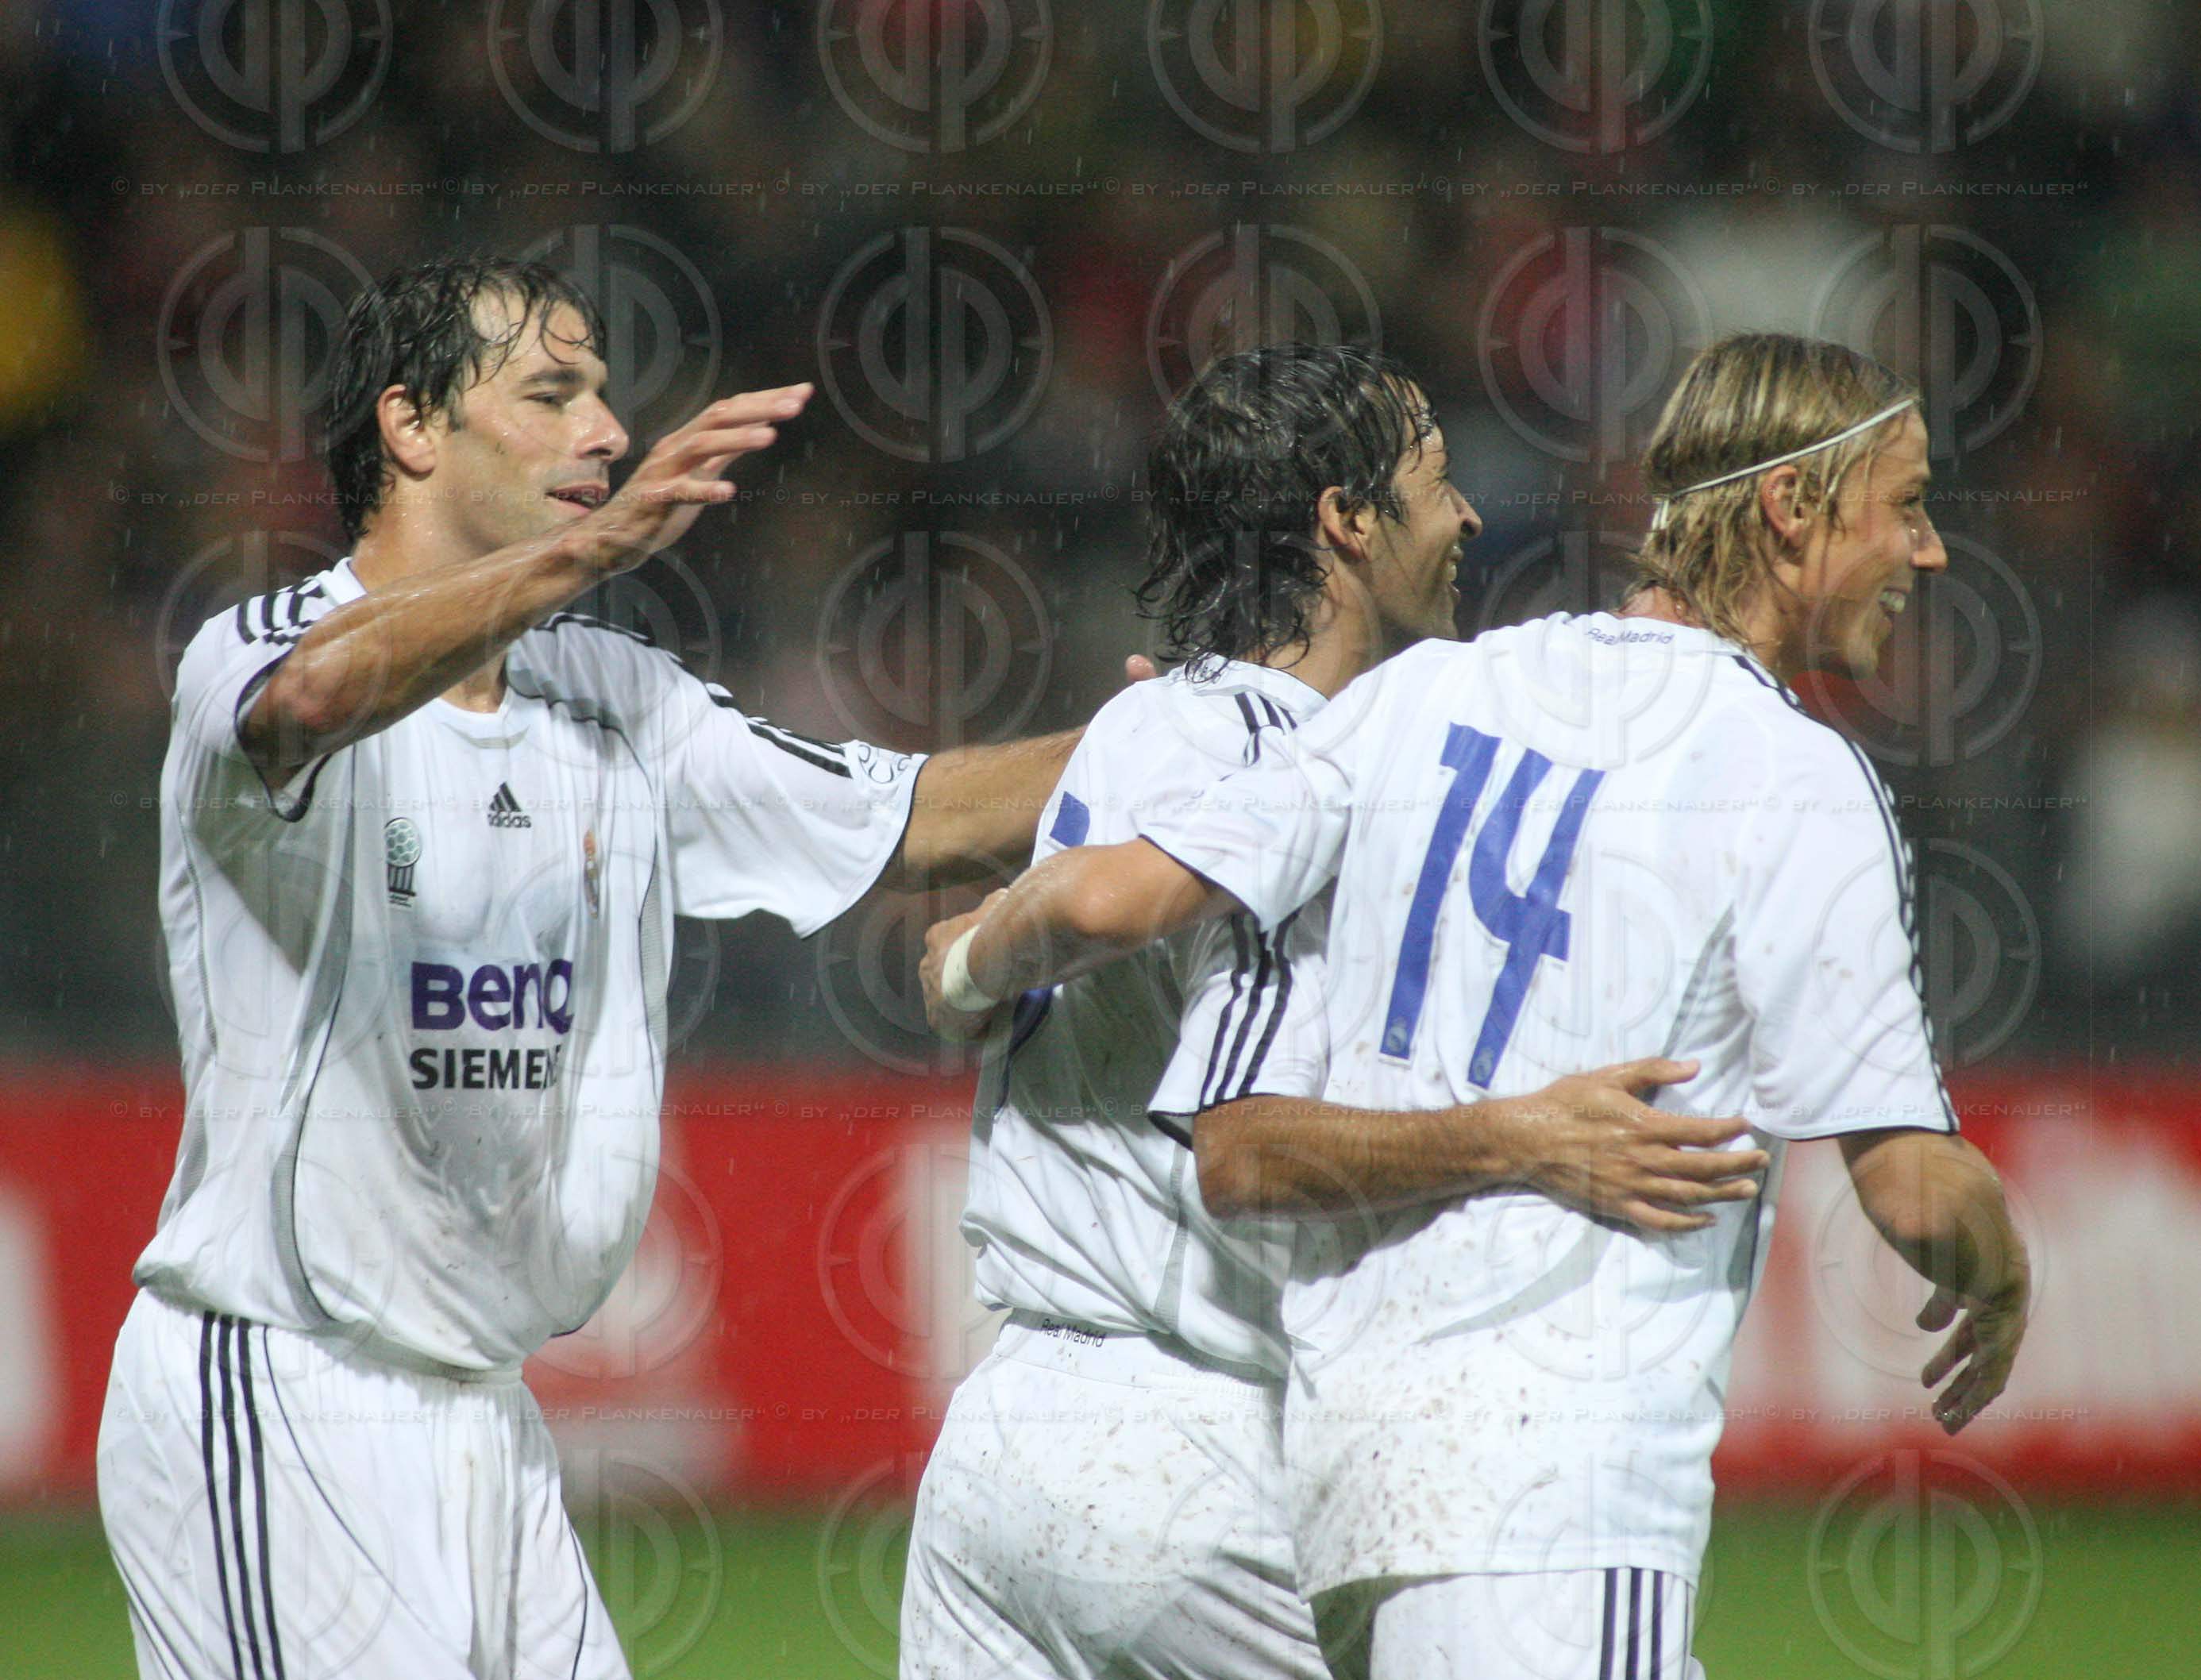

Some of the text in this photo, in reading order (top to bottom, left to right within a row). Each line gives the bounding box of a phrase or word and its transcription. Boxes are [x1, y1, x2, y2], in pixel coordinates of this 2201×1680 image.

[1379, 722, 1606, 1089] 14
[411, 958, 575, 1035] BenQ
[1063, 1324, 1107, 1347] Madrid
